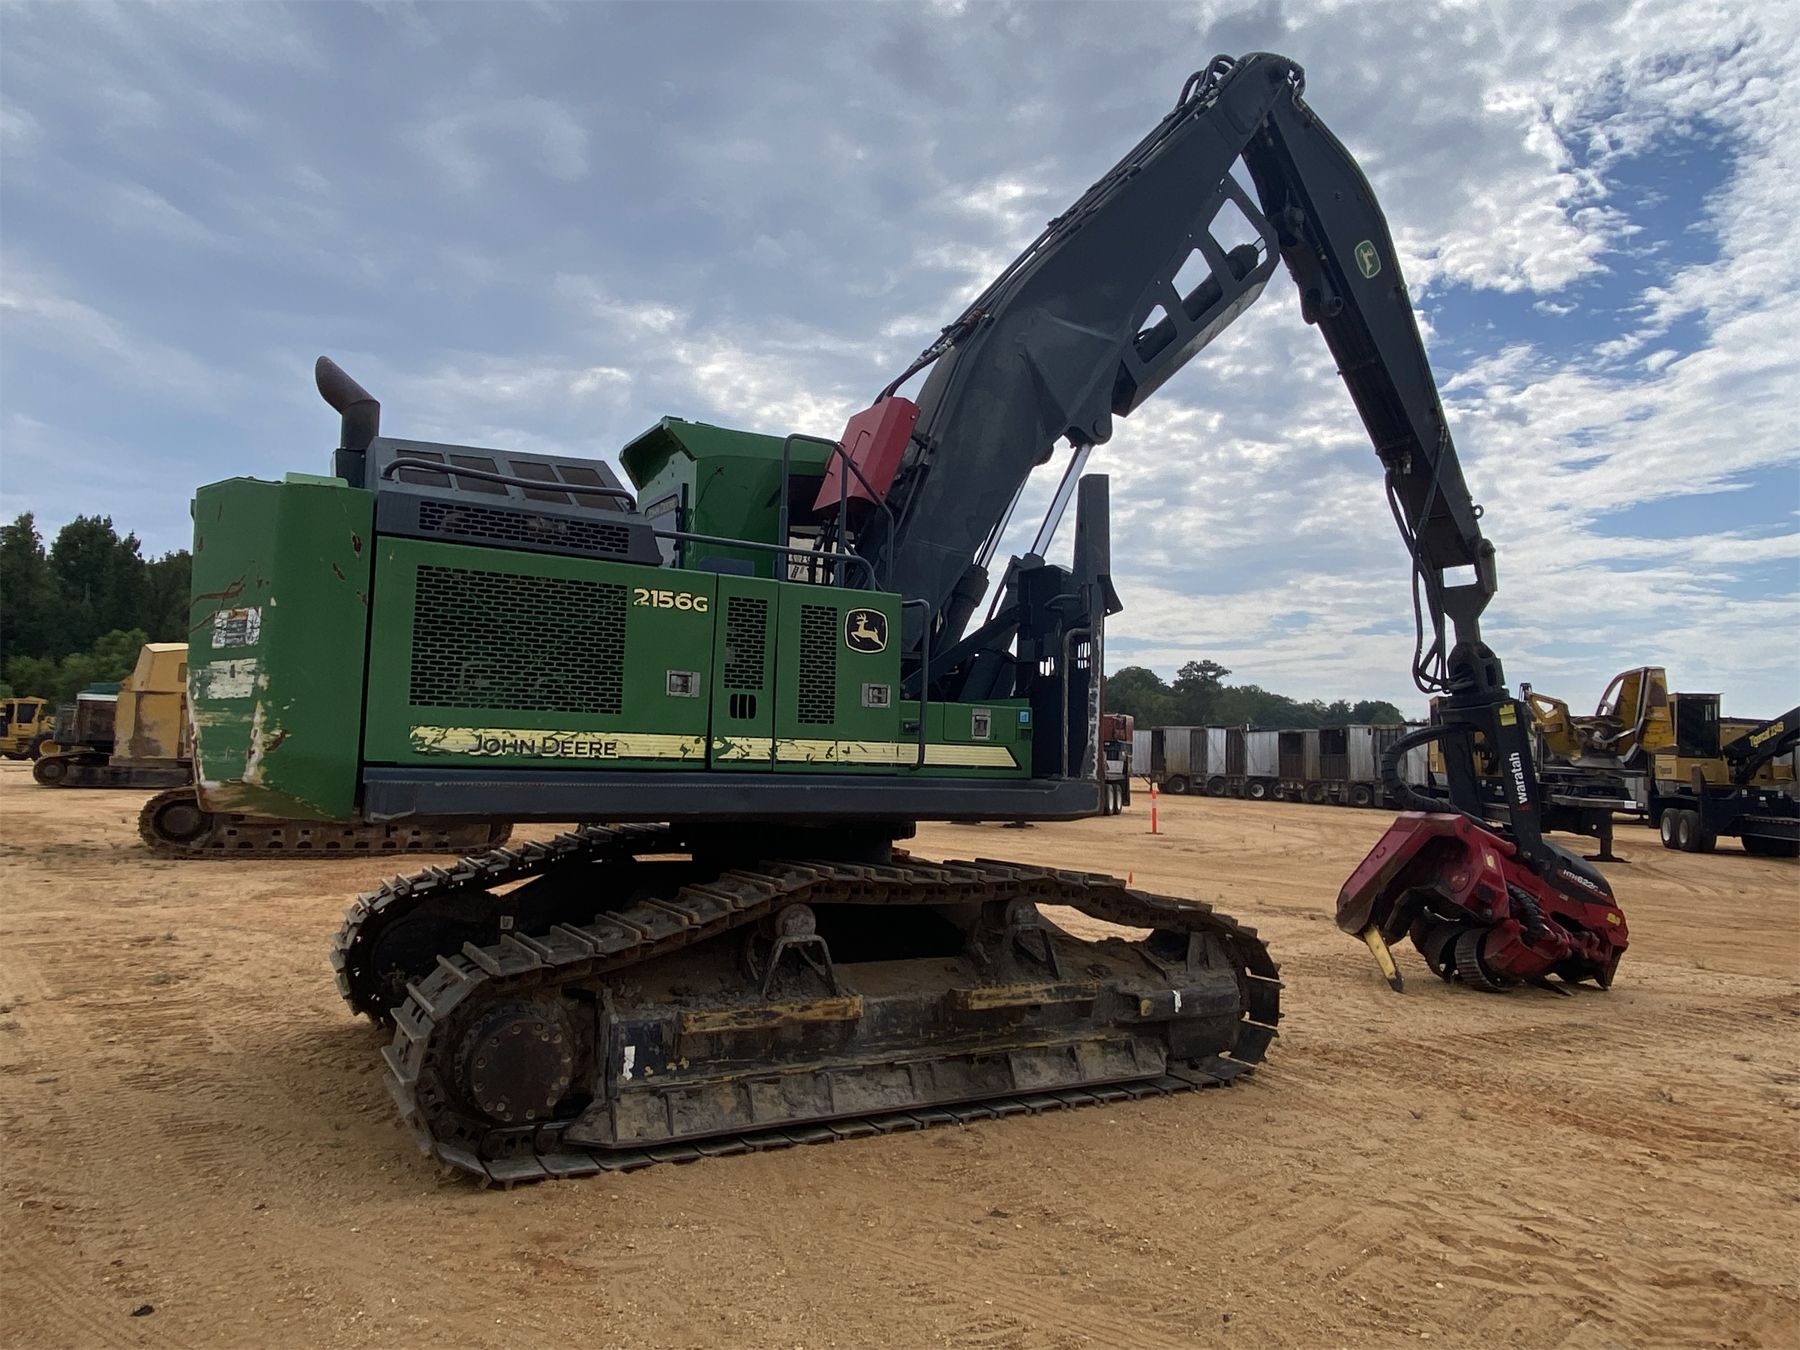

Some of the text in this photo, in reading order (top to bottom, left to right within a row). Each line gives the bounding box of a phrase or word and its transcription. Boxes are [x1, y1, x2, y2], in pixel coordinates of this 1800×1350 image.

[633, 587, 708, 612] 2156G
[468, 734, 617, 757] JOHN DEERE
[1508, 752, 1528, 804] waratah
